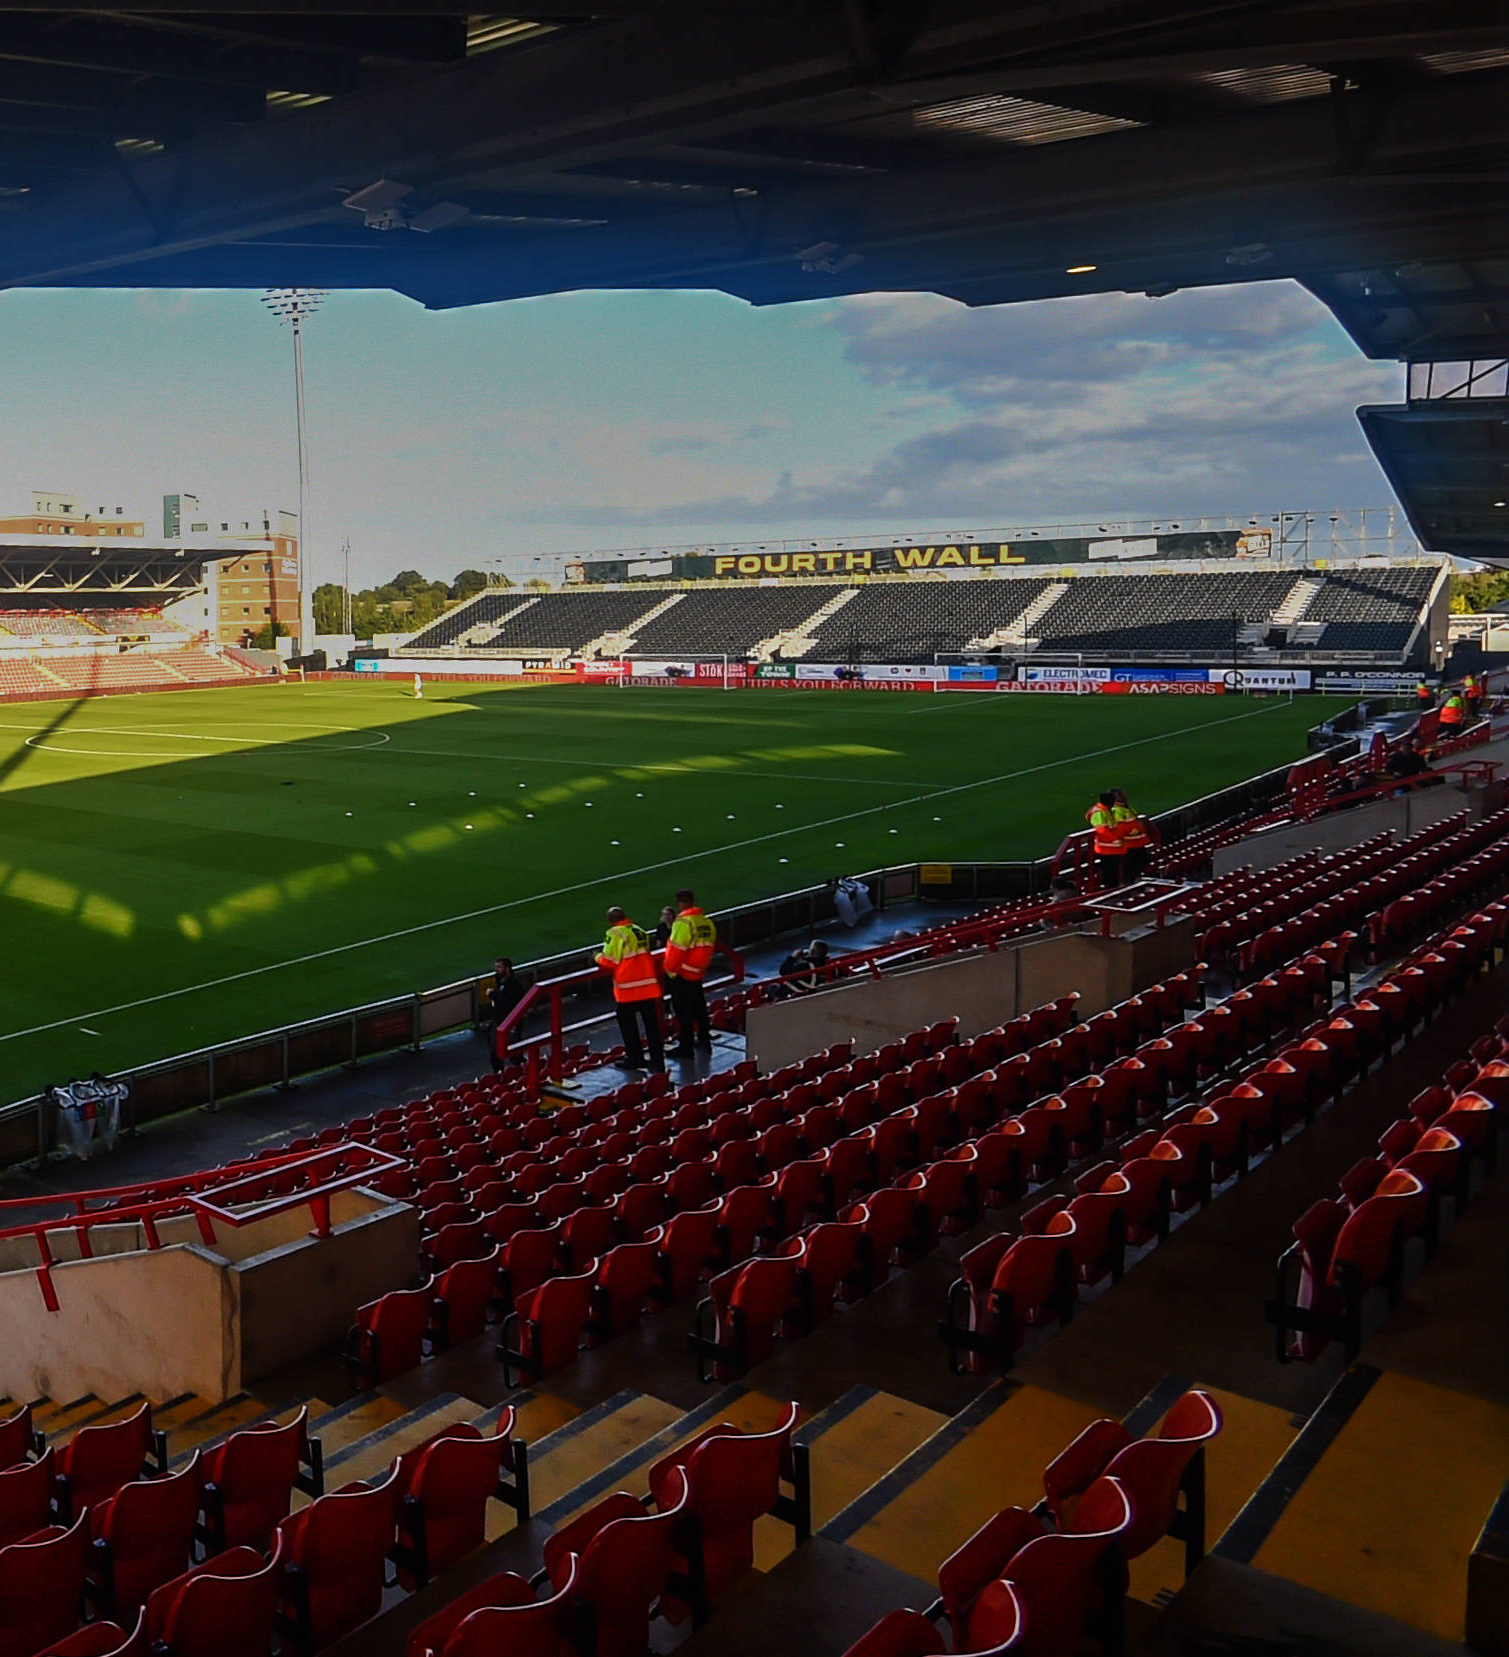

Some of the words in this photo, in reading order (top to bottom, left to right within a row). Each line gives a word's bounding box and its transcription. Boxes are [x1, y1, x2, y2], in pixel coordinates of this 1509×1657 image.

[714, 551, 872, 575] FOURTH
[894, 544, 1026, 569] WALL
[1354, 671, 1425, 679] O'CONNOR
[605, 676, 677, 686] GATORADE
[996, 681, 1104, 693] GATORADE
